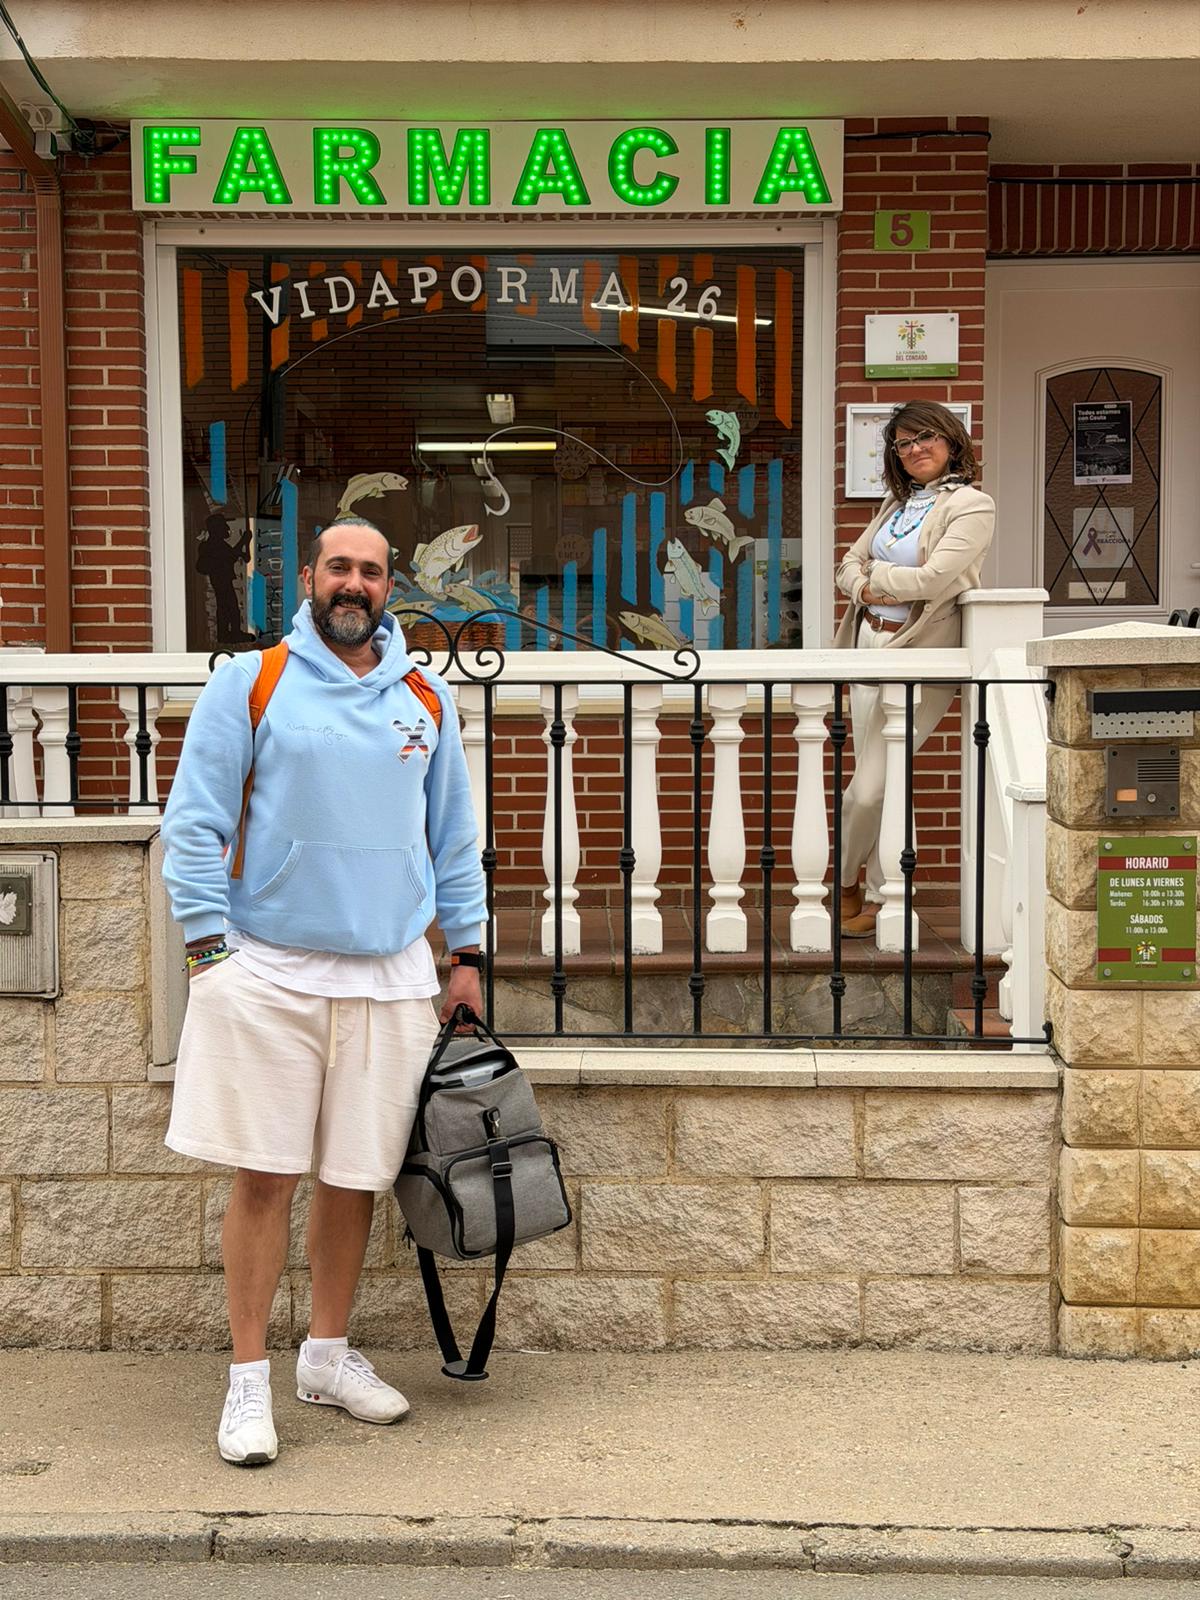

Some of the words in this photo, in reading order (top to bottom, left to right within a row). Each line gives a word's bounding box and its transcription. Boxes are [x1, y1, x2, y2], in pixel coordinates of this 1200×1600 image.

[143, 126, 833, 206] FARMACIA
[890, 213, 913, 246] 5
[251, 266, 628, 325] VIDAPORMA
[666, 277, 722, 320] 26
[1125, 857, 1169, 869] HORARIO
[1109, 877, 1120, 887] DE
[1121, 877, 1145, 887] LUNES
[1146, 878, 1152, 887] A
[1152, 877, 1185, 887] VIERNES
[1130, 913, 1164, 924] SÁBADOS
